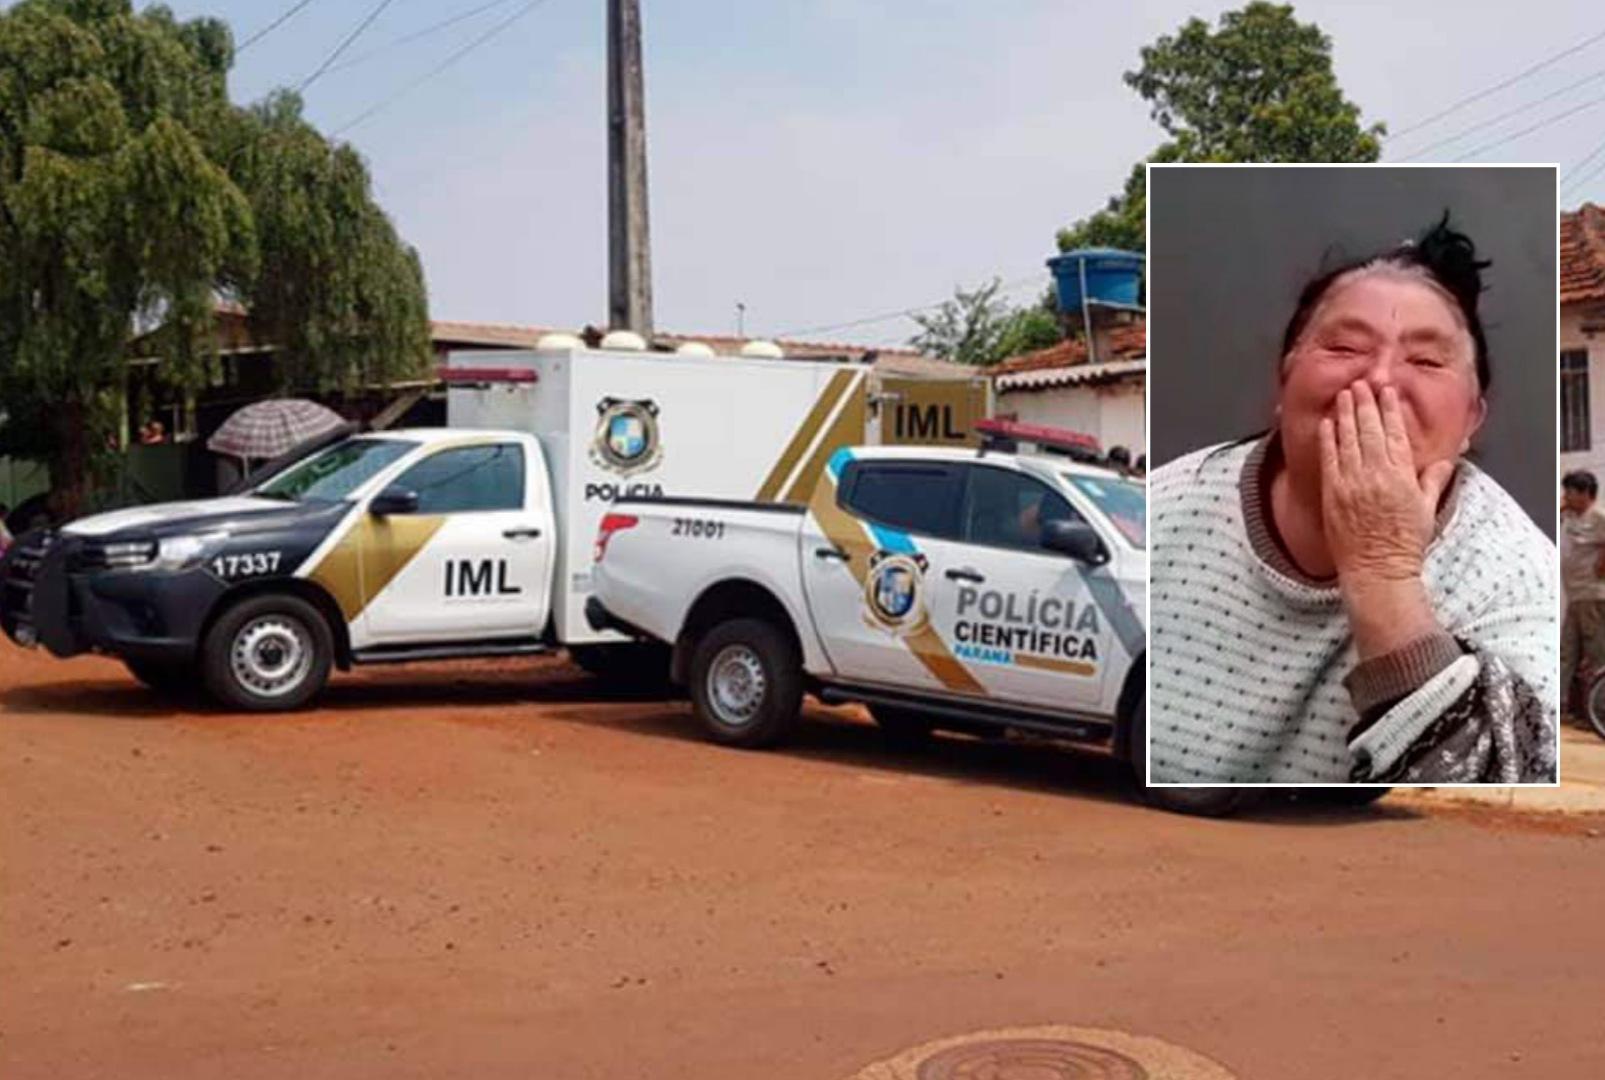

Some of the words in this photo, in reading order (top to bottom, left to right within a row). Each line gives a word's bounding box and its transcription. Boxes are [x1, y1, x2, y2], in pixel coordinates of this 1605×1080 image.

[896, 404, 965, 439] IML
[672, 518, 726, 538] 21001
[213, 552, 281, 576] 17337
[445, 559, 522, 597] IML
[956, 588, 1099, 634] POLÍCIA
[954, 621, 1098, 660] CIENTÍFICA
